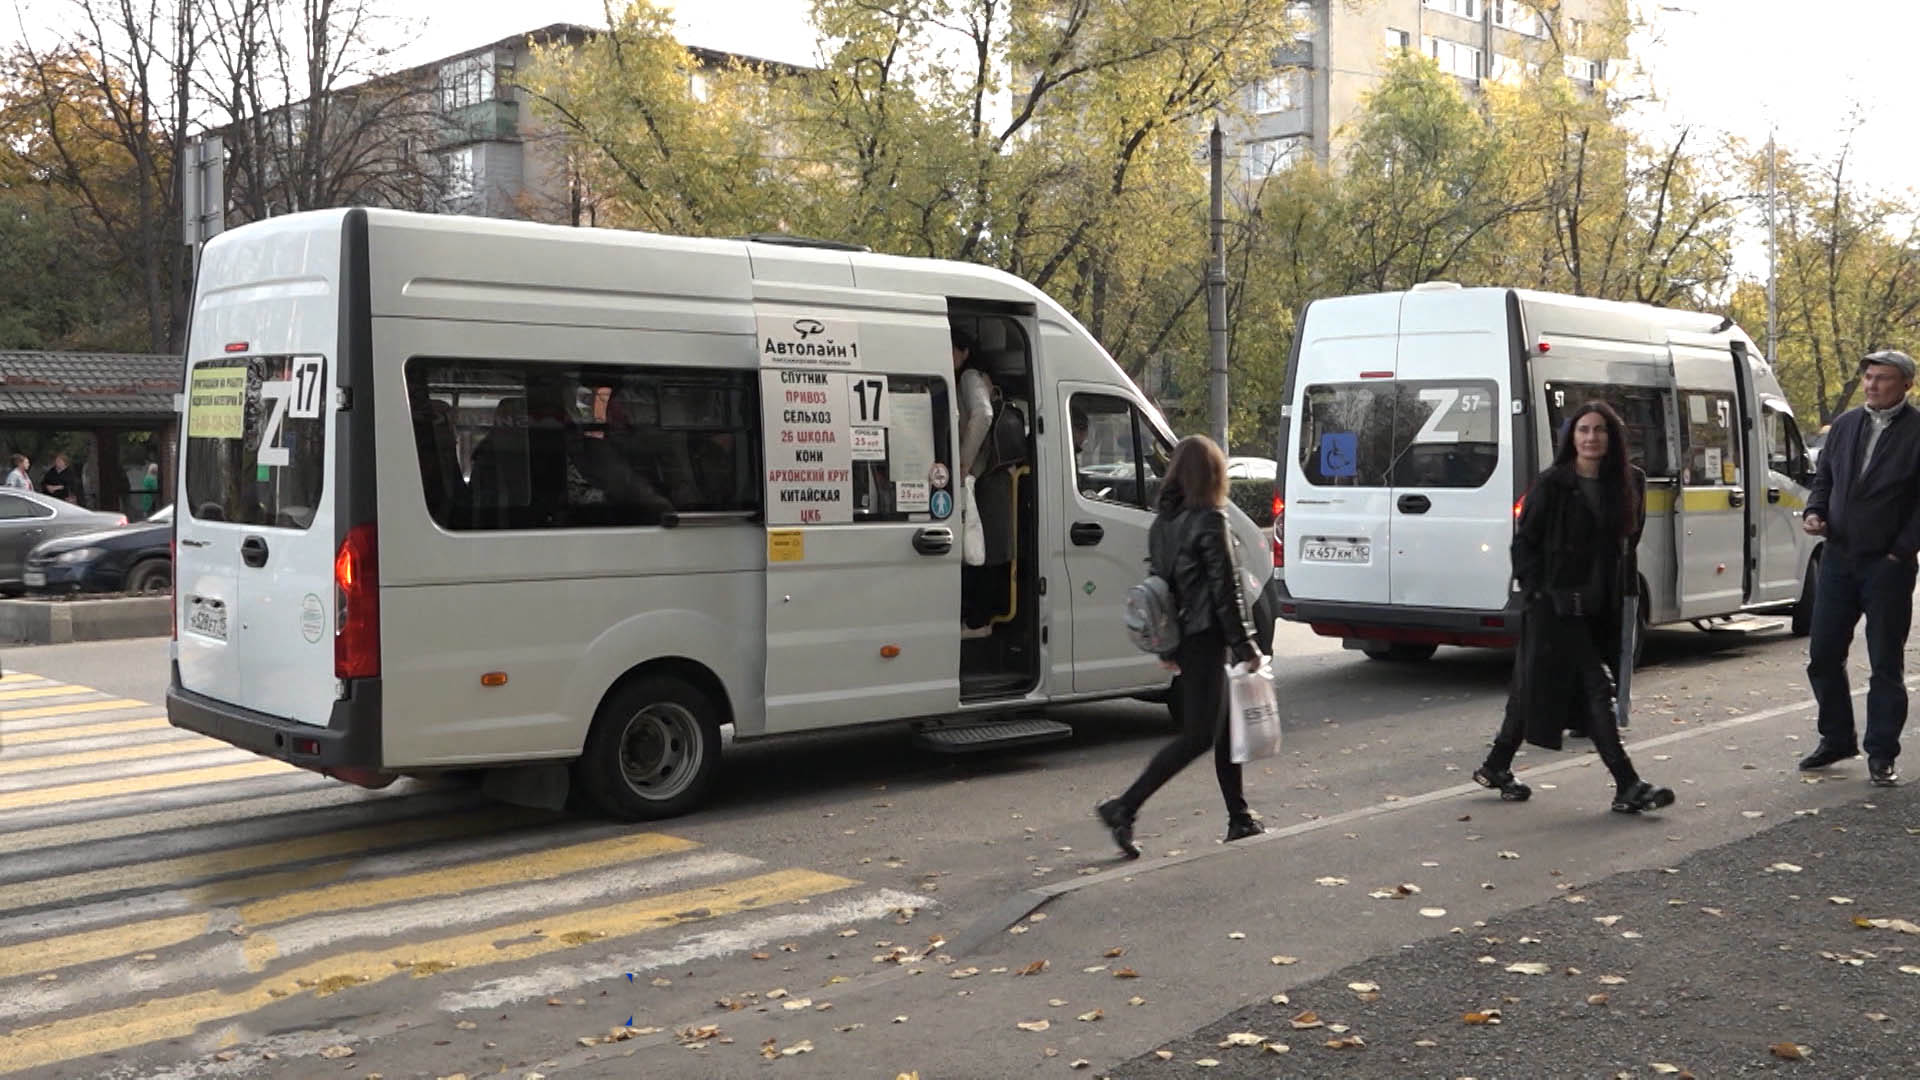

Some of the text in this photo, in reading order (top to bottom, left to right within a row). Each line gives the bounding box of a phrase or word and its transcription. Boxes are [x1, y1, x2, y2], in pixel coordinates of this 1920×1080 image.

[765, 338, 857, 358] Автолайн 1
[781, 371, 828, 384] СПУТНИК
[296, 363, 318, 411] 17
[785, 391, 827, 404] ПРИВОЗ
[853, 379, 883, 421] 17
[1462, 396, 1480, 411] 57
[1555, 391, 1565, 407] 57
[783, 410, 831, 424] СЕЛЬХОЗ
[1413, 389, 1459, 442] Z
[1716, 400, 1730, 428] 57
[257, 381, 293, 466] Z
[781, 430, 836, 443] 26 ШКОЛА
[855, 437, 866, 446] 25
[795, 450, 823, 462] КОНИ
[769, 469, 849, 483] АРХОНСКИЙ КРУГ
[780, 487, 840, 502] КИТАЙСКАЯ
[800, 509, 821, 524] ЦКБ
